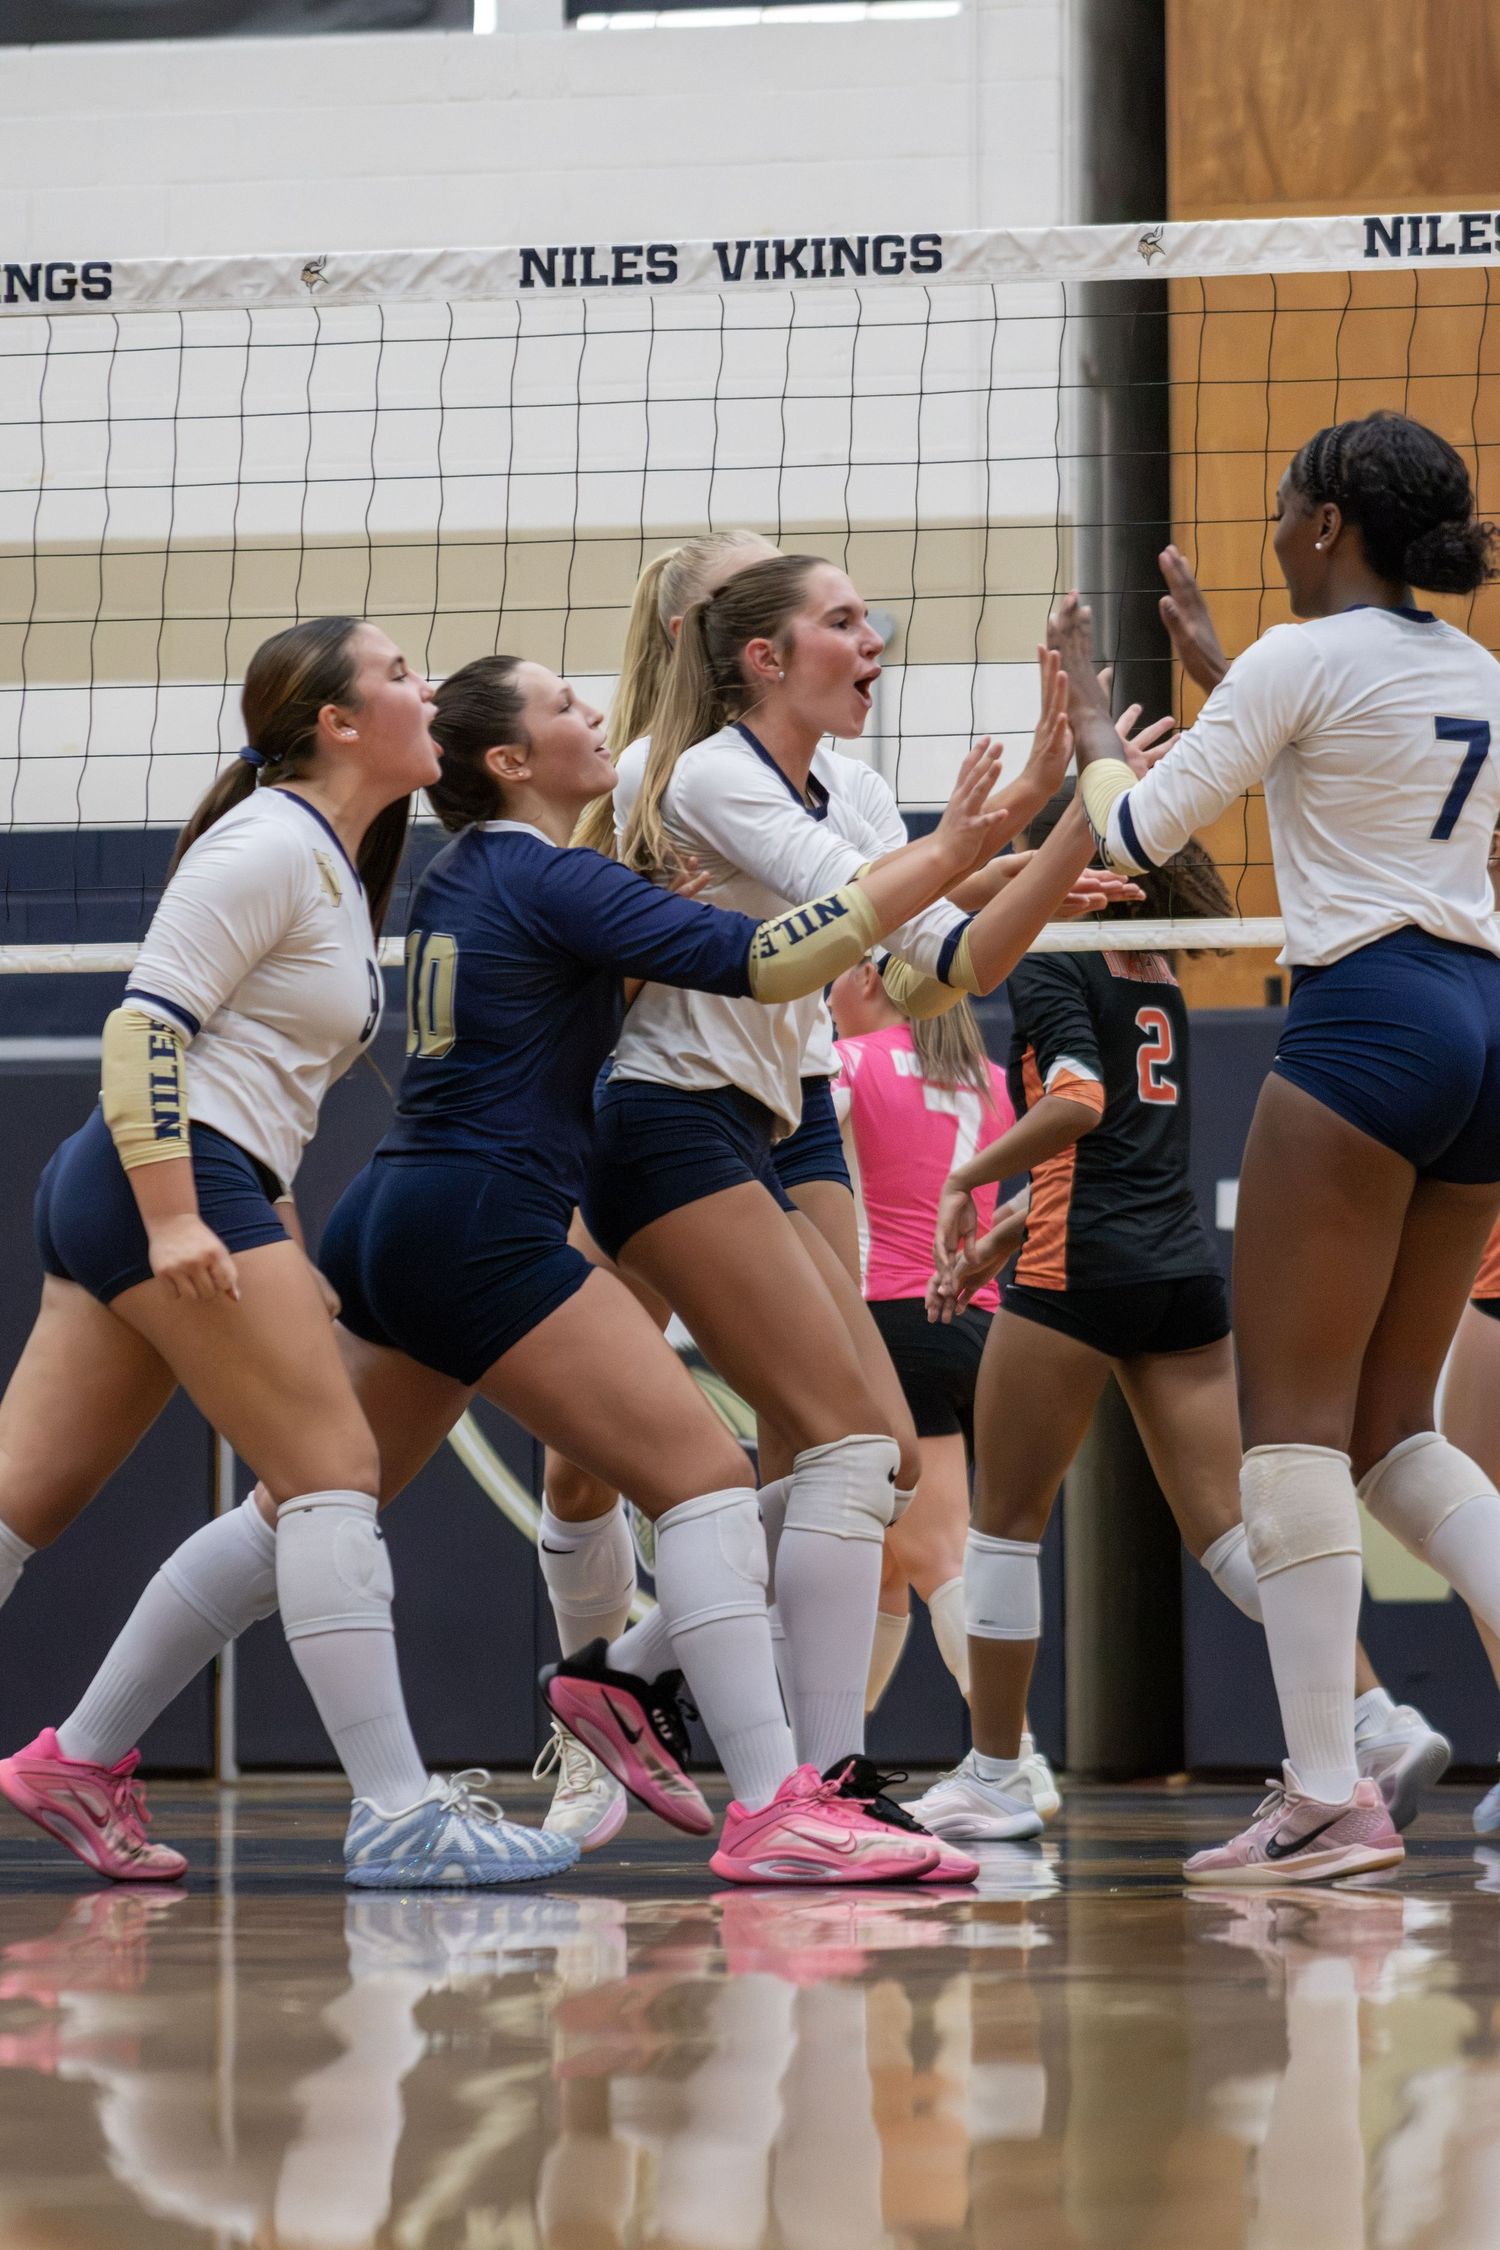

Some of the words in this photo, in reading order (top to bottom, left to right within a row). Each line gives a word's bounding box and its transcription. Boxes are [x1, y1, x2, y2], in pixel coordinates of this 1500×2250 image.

[519, 244, 678, 288] NILES
[712, 233, 943, 282] VIKINGS
[1363, 213, 1500, 257] NILE
[0, 261, 112, 303] NGS
[1430, 714, 1491, 841] 7
[753, 894, 849, 959] NILE
[1135, 1007, 1178, 1105] 2
[922, 1084, 982, 1173] 7
